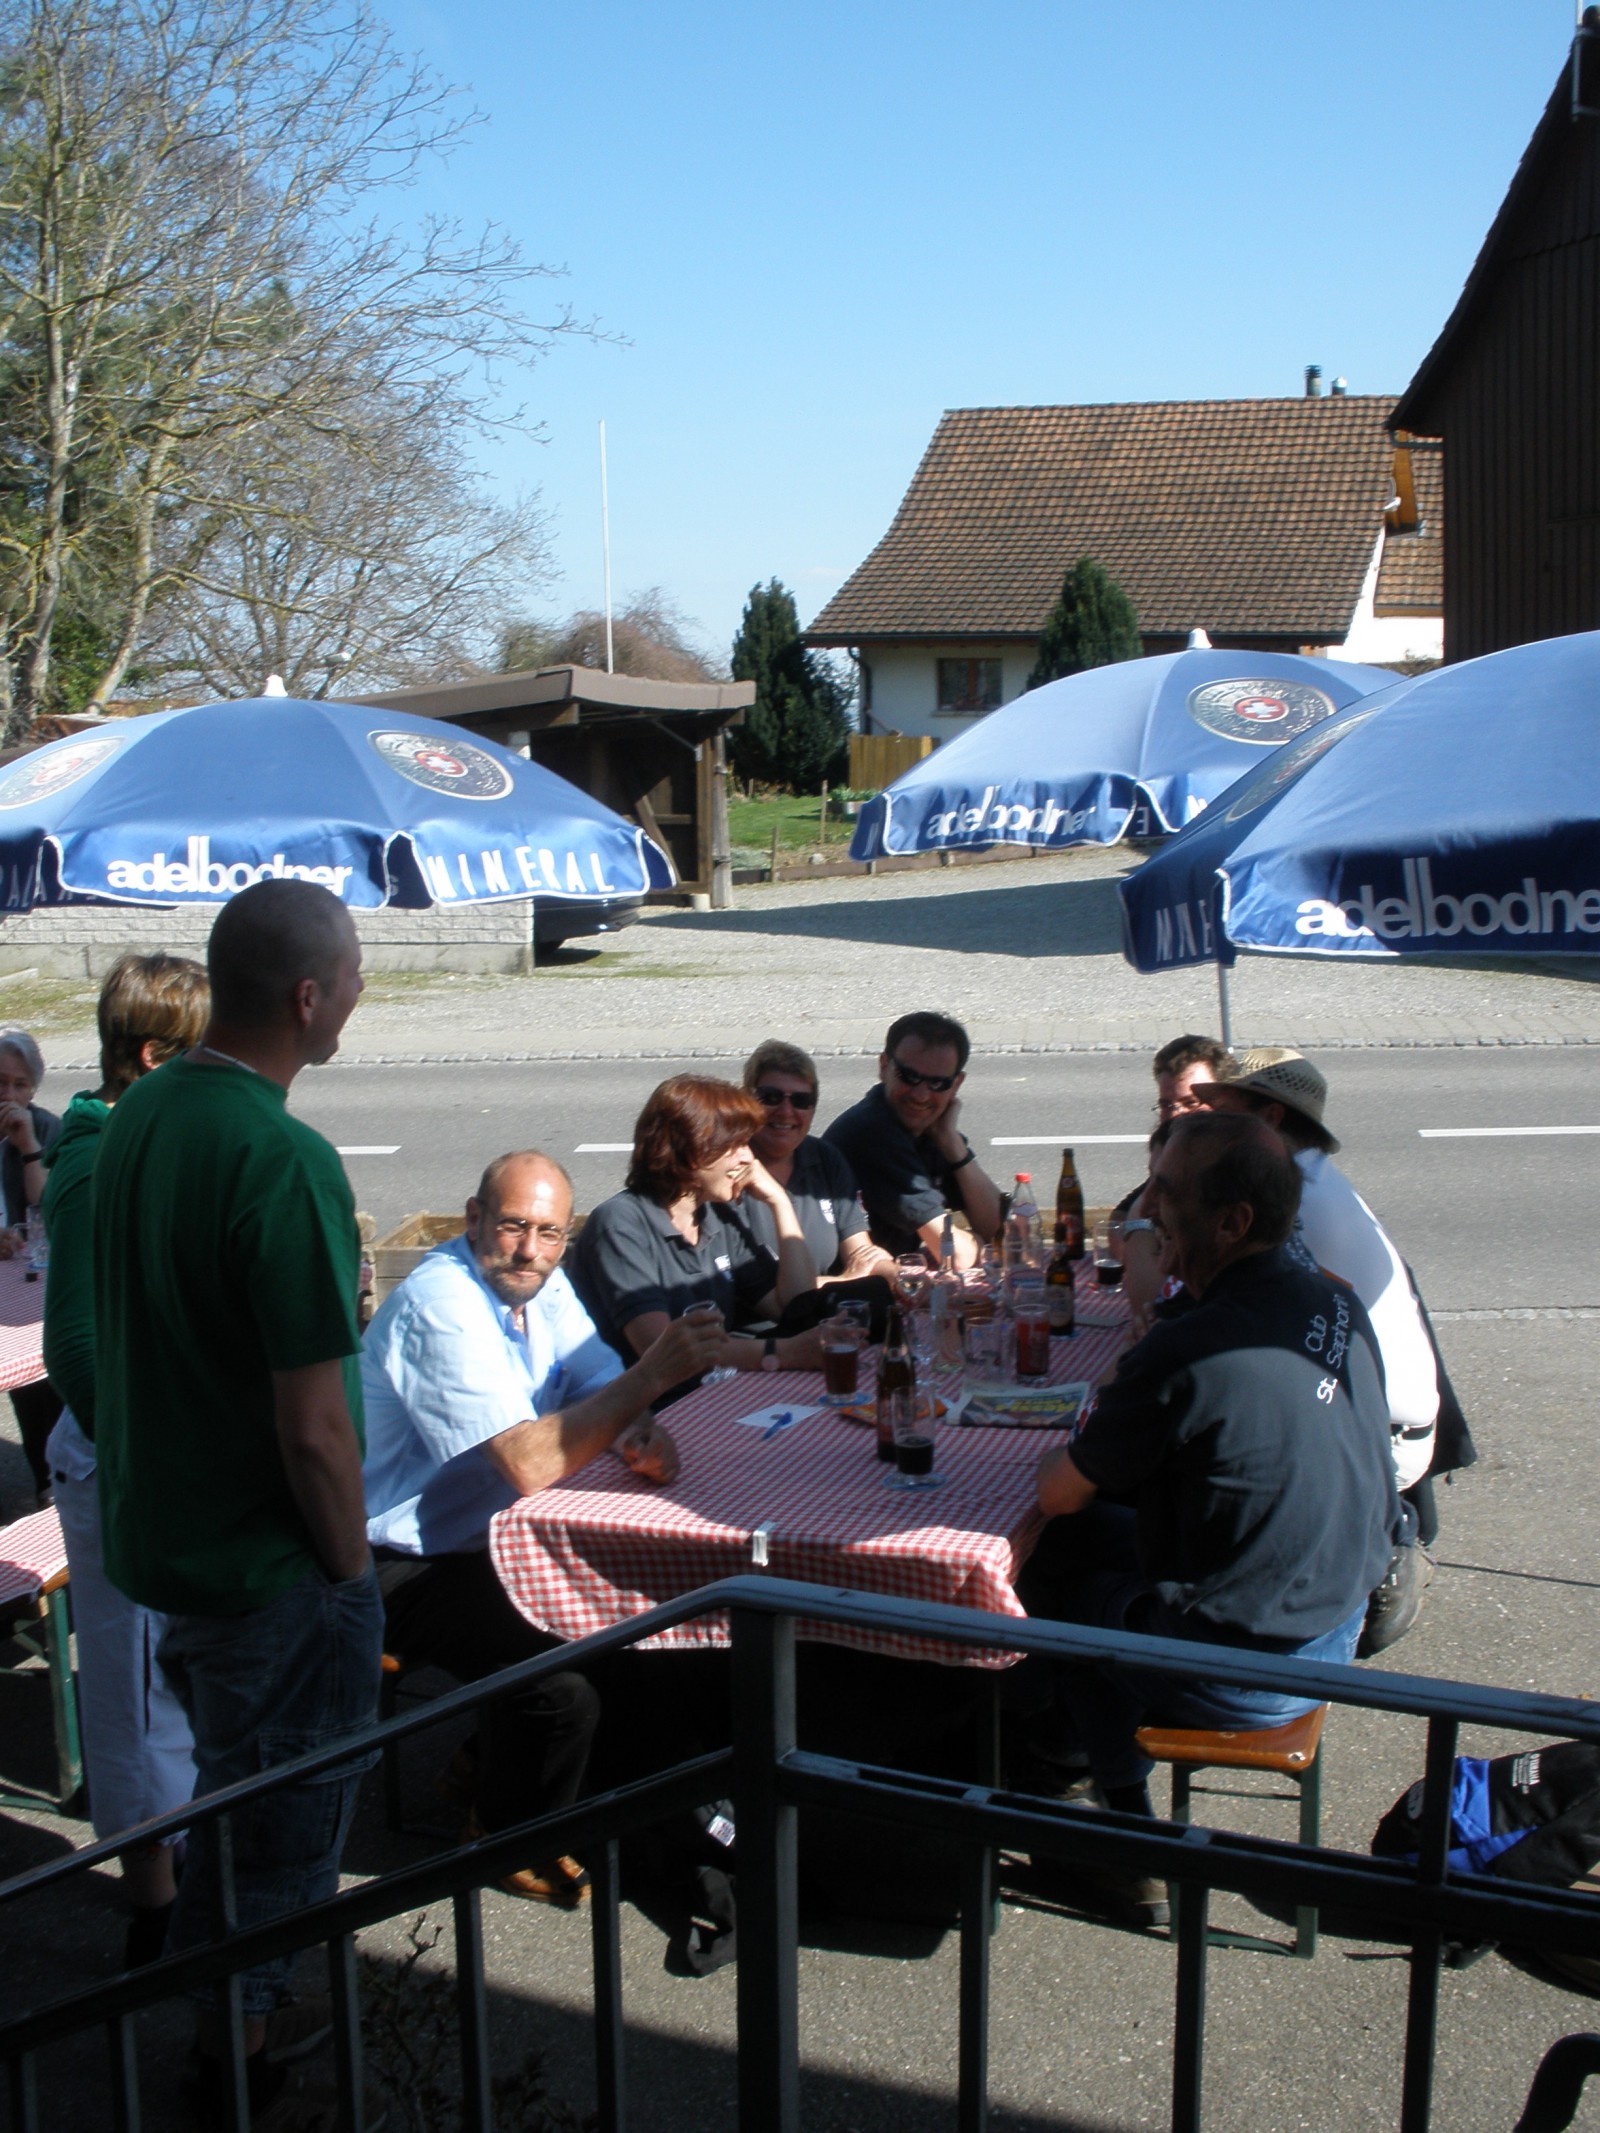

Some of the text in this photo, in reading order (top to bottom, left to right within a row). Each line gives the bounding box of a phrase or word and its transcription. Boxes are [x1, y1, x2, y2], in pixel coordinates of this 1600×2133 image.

[926, 785, 1096, 839] adelbodner
[426, 845, 615, 899] MINERAL
[1304, 1314, 1327, 1352] Club
[1316, 1377, 1338, 1404] St.
